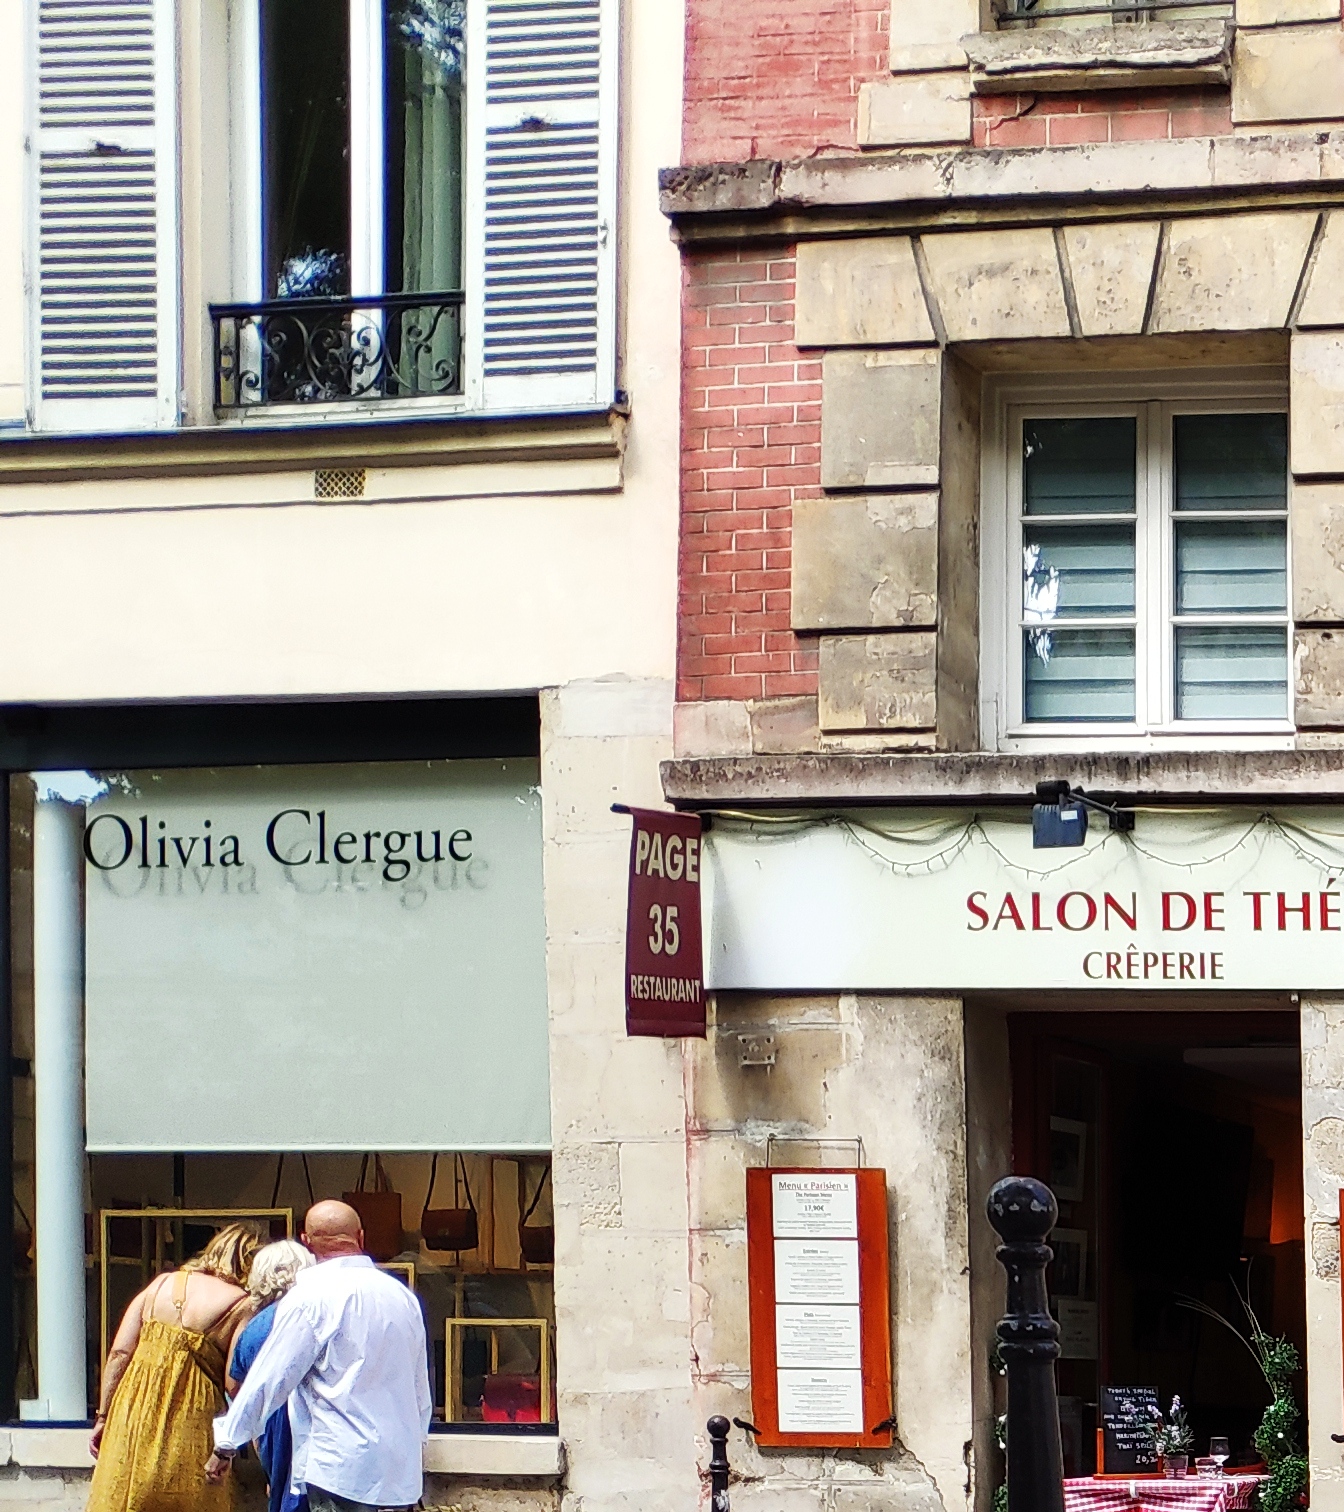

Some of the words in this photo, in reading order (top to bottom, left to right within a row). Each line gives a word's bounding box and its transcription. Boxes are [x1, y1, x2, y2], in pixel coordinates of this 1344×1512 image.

[83, 813, 244, 870] Olivia
[266, 808, 473, 882] Clergue
[635, 829, 699, 882] PAGE
[648, 903, 680, 956] 35
[966, 890, 1138, 932] SALON
[1161, 890, 1226, 932] DE
[1242, 877, 1342, 932] THÉ
[1082, 942, 1225, 980] CRÊPERIE
[630, 974, 701, 1003] RESTAURANT
